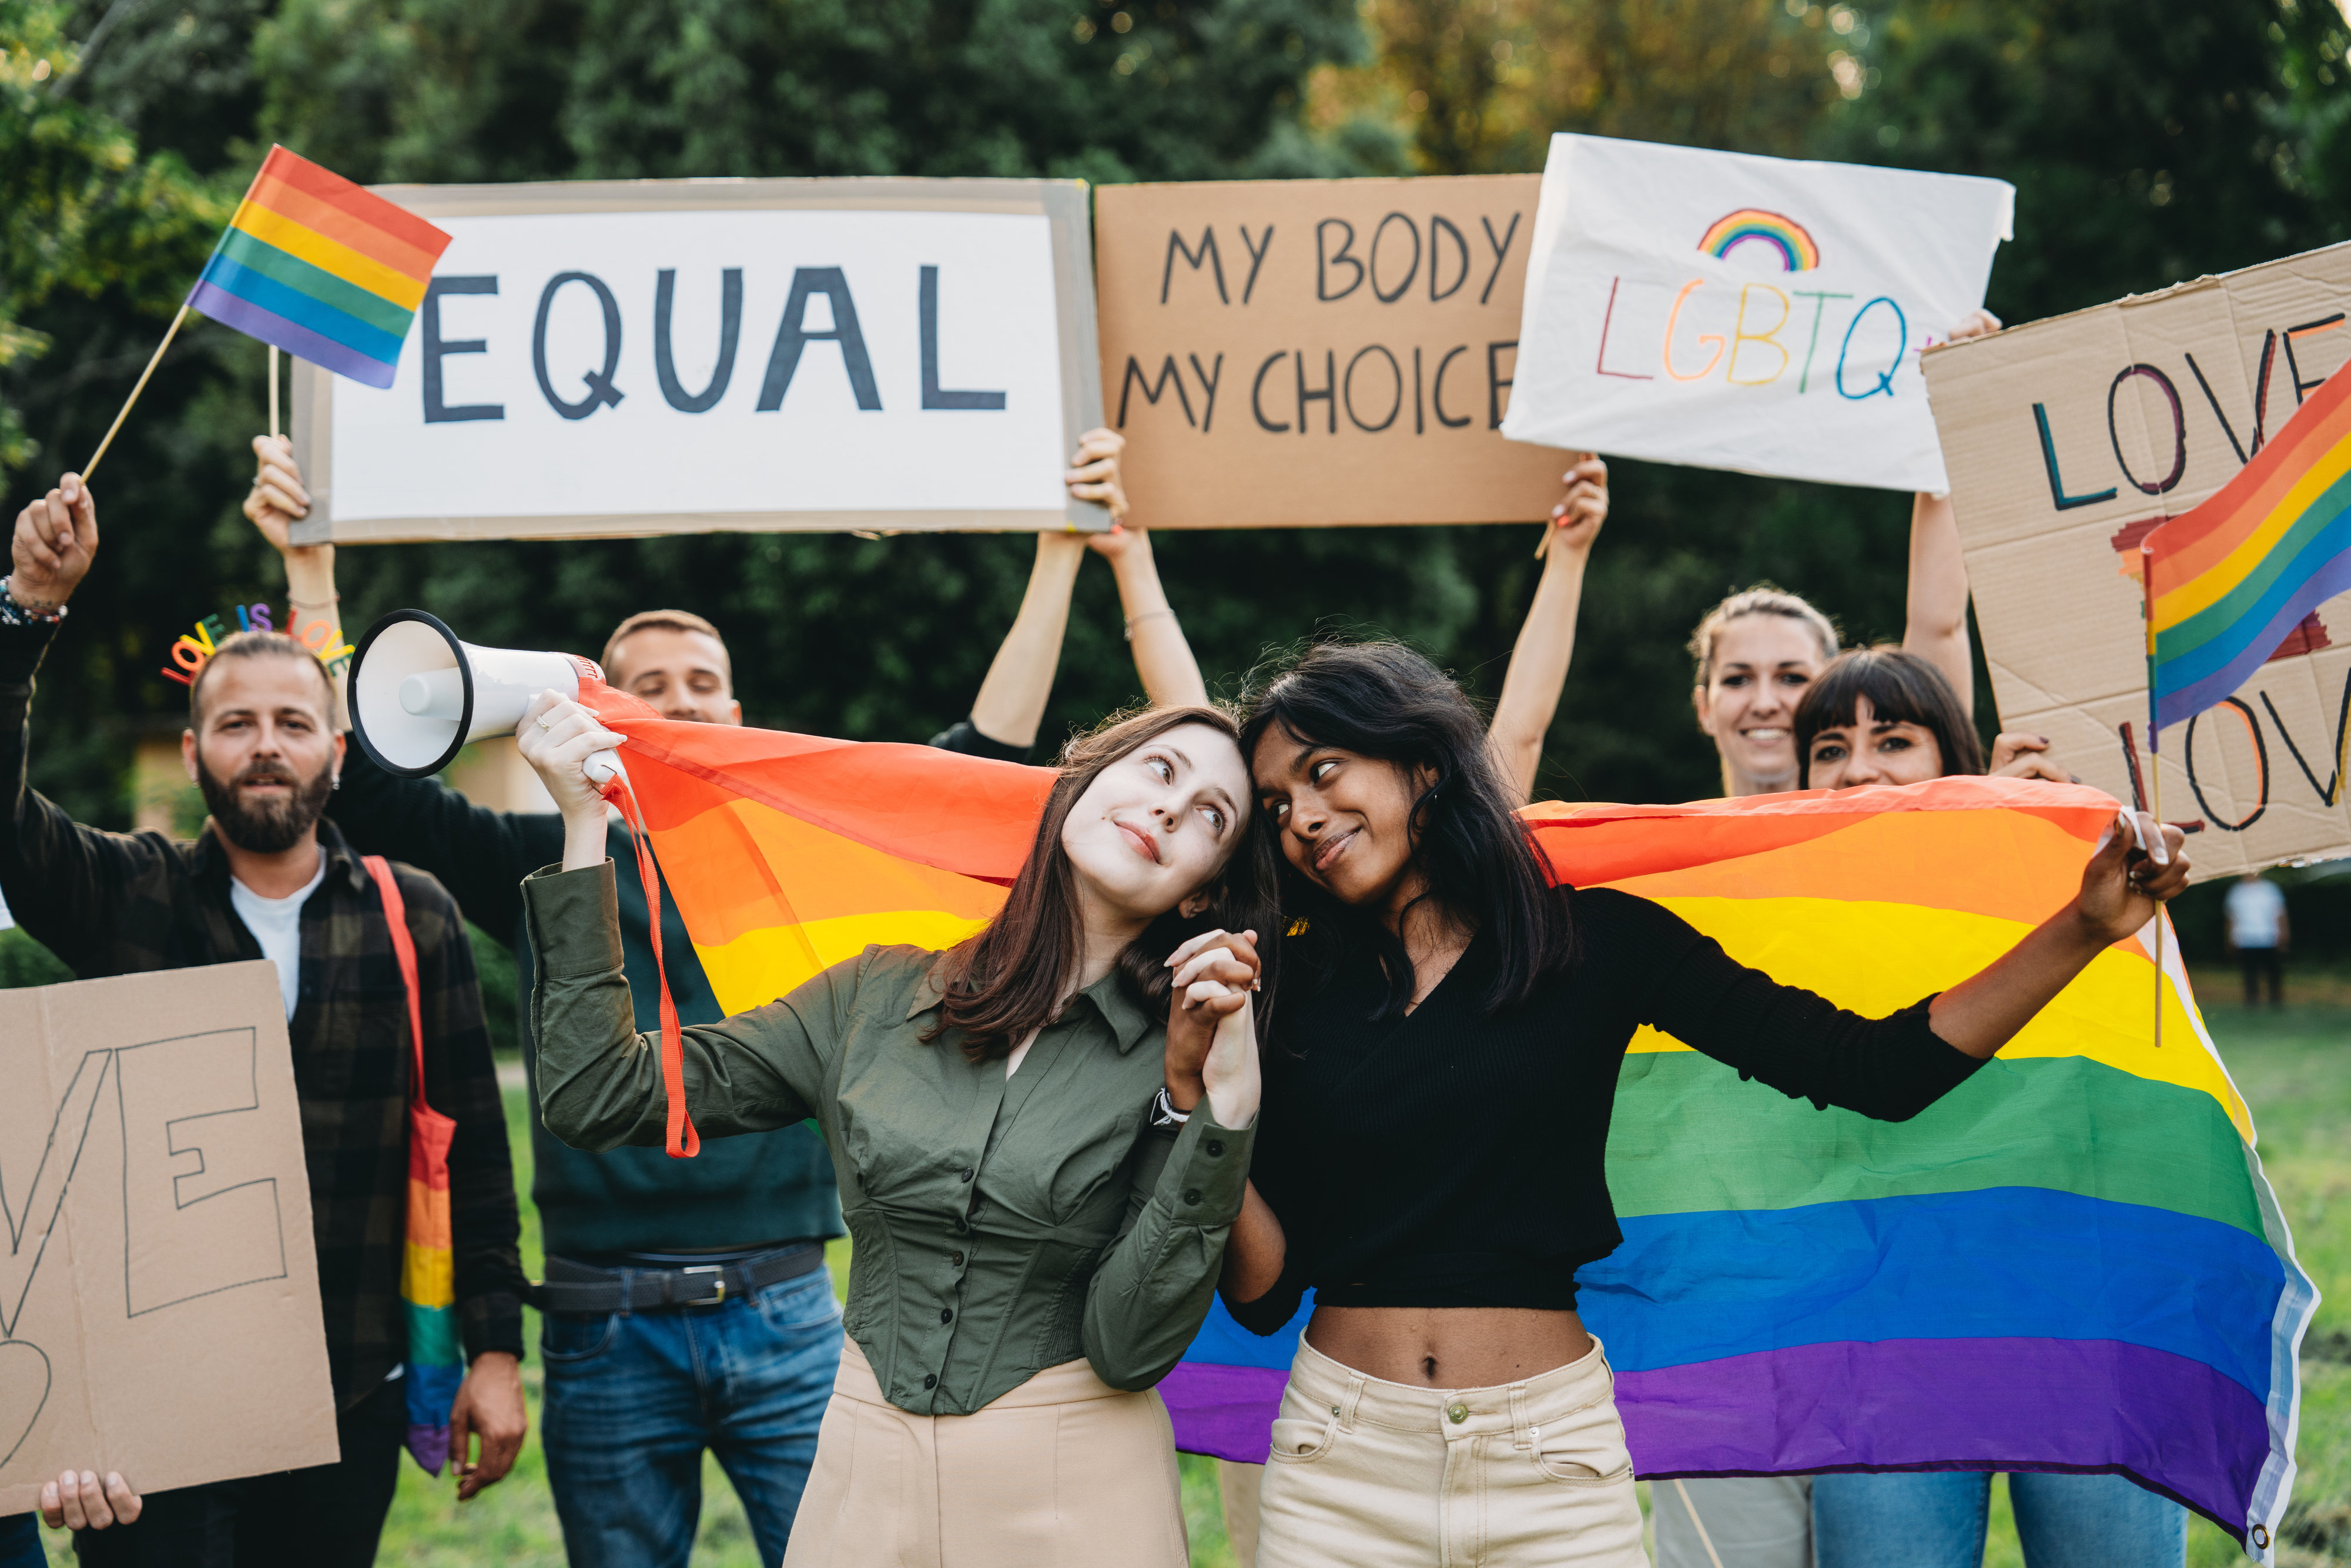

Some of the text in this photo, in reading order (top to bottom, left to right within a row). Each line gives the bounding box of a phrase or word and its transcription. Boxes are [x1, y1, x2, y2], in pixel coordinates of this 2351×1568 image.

[1160, 211, 1522, 306] MY BODY
[421, 264, 1007, 424] EQUAL
[1117, 339, 1519, 435] MY CHOICE
[160, 602, 356, 687] LOVE IS LOVE
